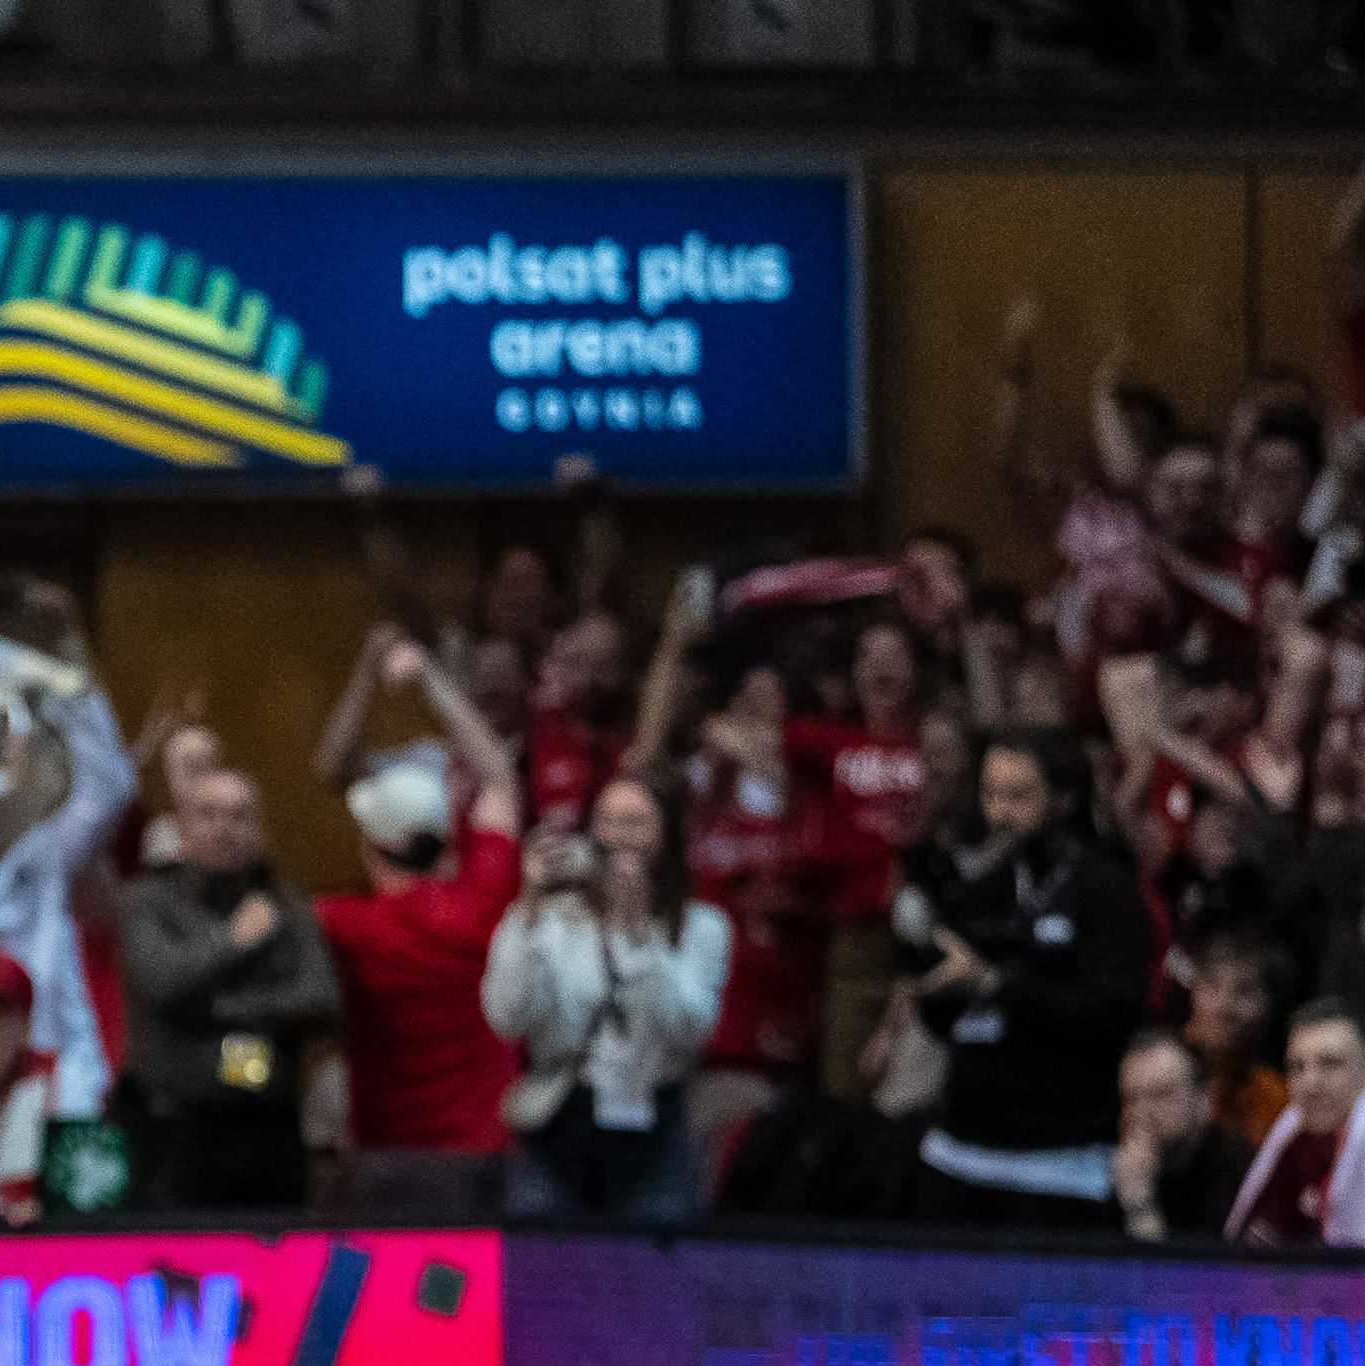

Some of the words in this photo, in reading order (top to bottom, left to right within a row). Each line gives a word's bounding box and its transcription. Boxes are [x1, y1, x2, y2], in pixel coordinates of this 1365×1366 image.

[402, 230, 630, 319] polsat
[637, 230, 794, 317] plus
[489, 317, 703, 378] arena
